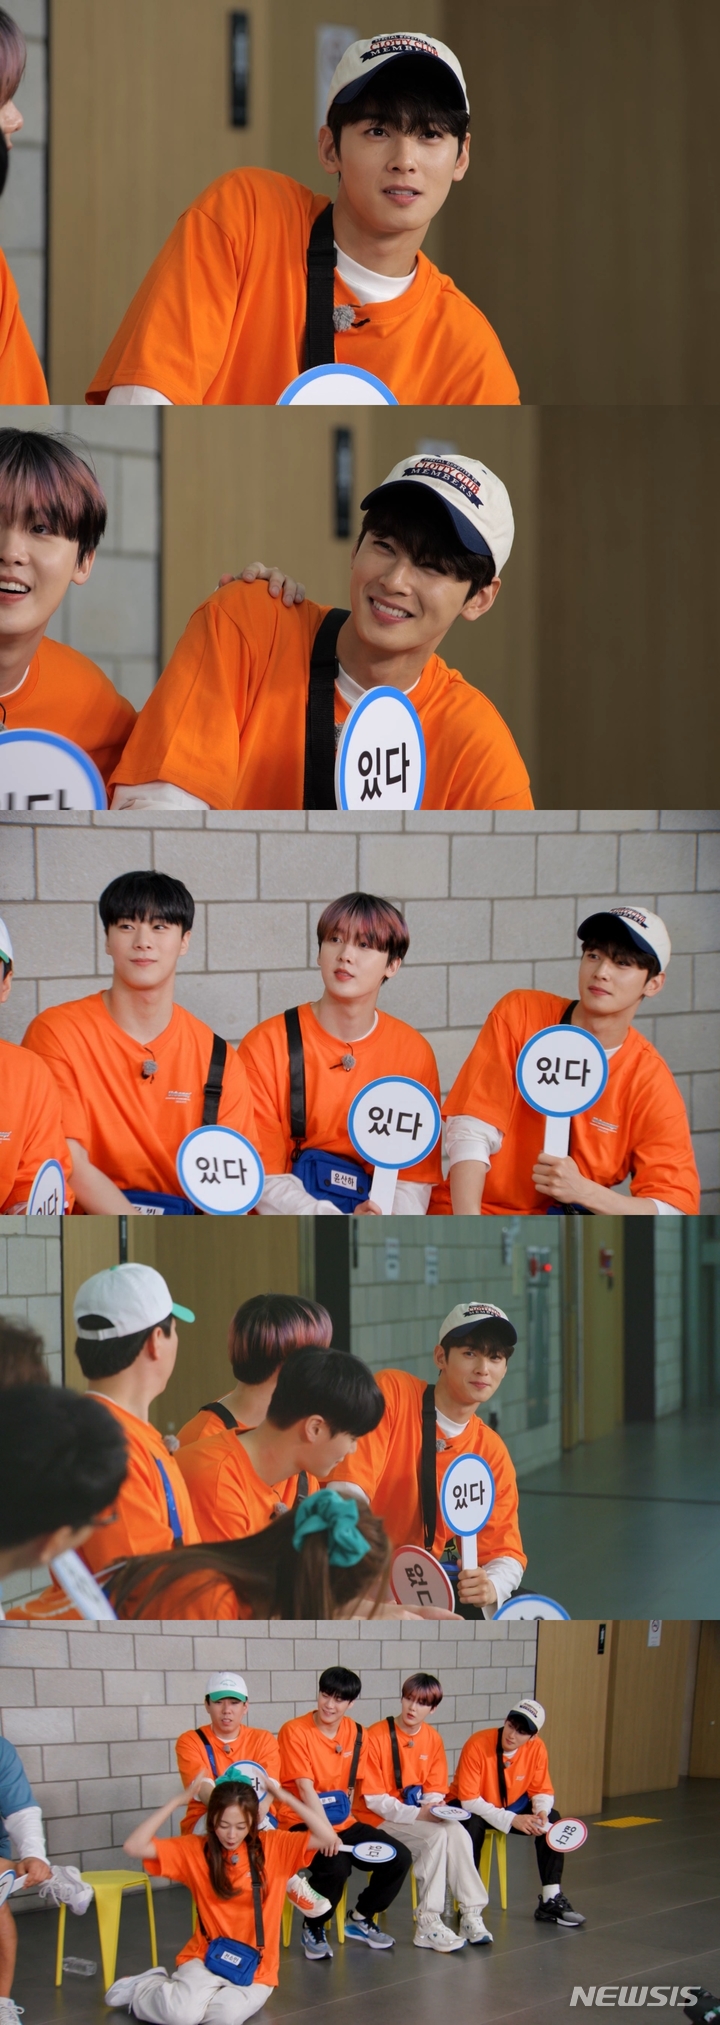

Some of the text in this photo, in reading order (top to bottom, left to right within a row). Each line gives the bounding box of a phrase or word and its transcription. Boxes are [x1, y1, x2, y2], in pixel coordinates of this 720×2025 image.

[370, 39, 411, 50] CLOTTY
[414, 41, 438, 57] CLUB
[411, 468, 473, 498] MEMBERS
[415, 461, 480, 495] CLOTTY CLUB
[358, 742, 410, 802] 있다
[536, 1057, 591, 1087] 있다
[368, 1106, 423, 1141] 있다
[195, 1156, 248, 1186] 있다
[333, 1172, 355, 1187] 윤산하
[453, 1480, 485, 1510] 있다
[555, 1825, 577, 1845] 없다
